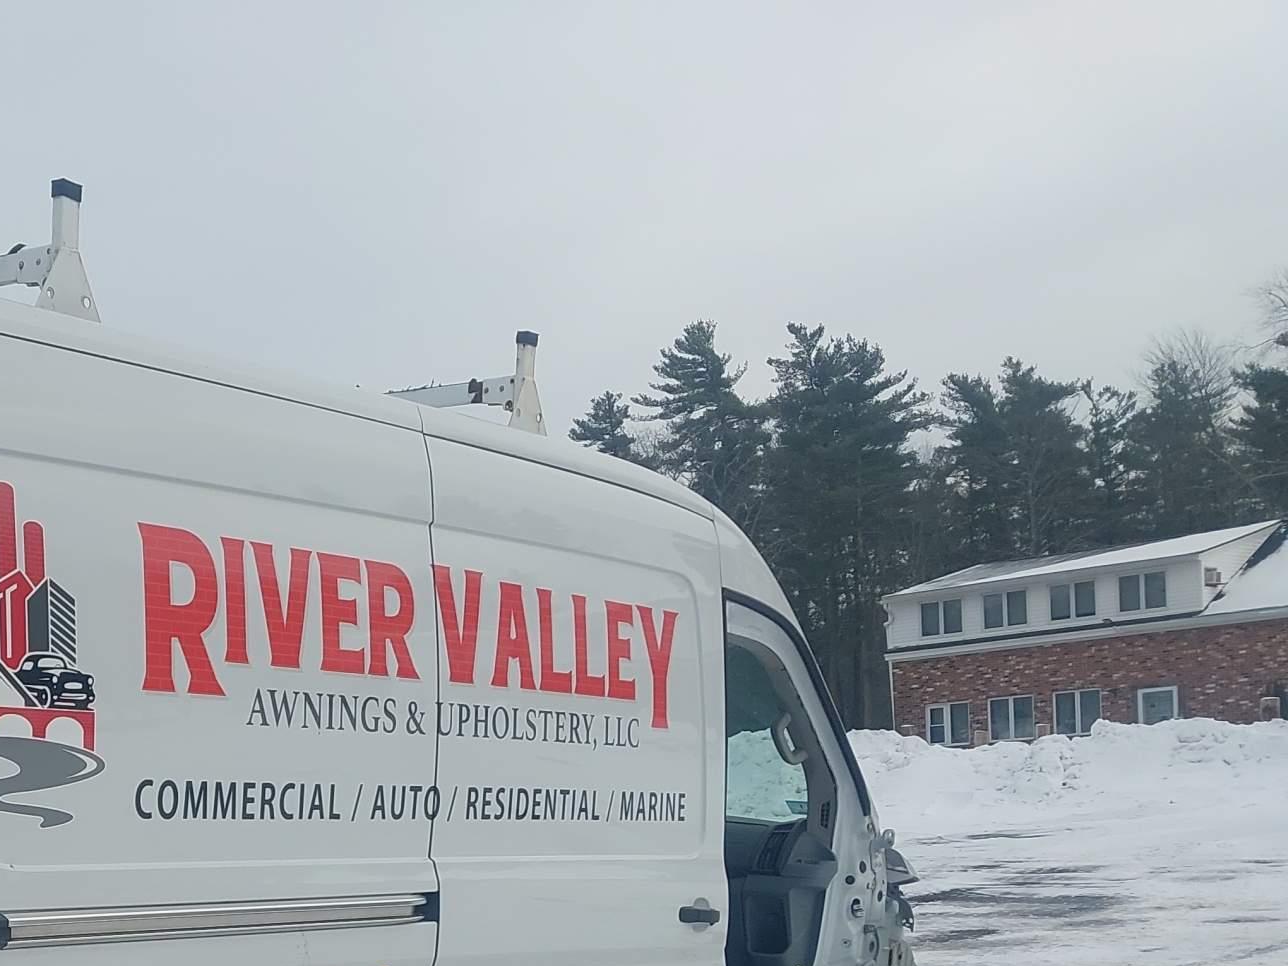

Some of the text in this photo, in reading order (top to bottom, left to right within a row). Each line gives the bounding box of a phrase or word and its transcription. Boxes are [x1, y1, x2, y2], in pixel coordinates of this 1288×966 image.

[138, 521, 679, 729] RIVER VALLEY
[246, 688, 640, 751] AWNINGS & UPHOLSTERY, LLC
[134, 778, 342, 821] COMMERCIAL
[369, 784, 441, 821] AUTO
[465, 787, 601, 822] RESIDENTIAL
[619, 791, 687, 822] MARINE
